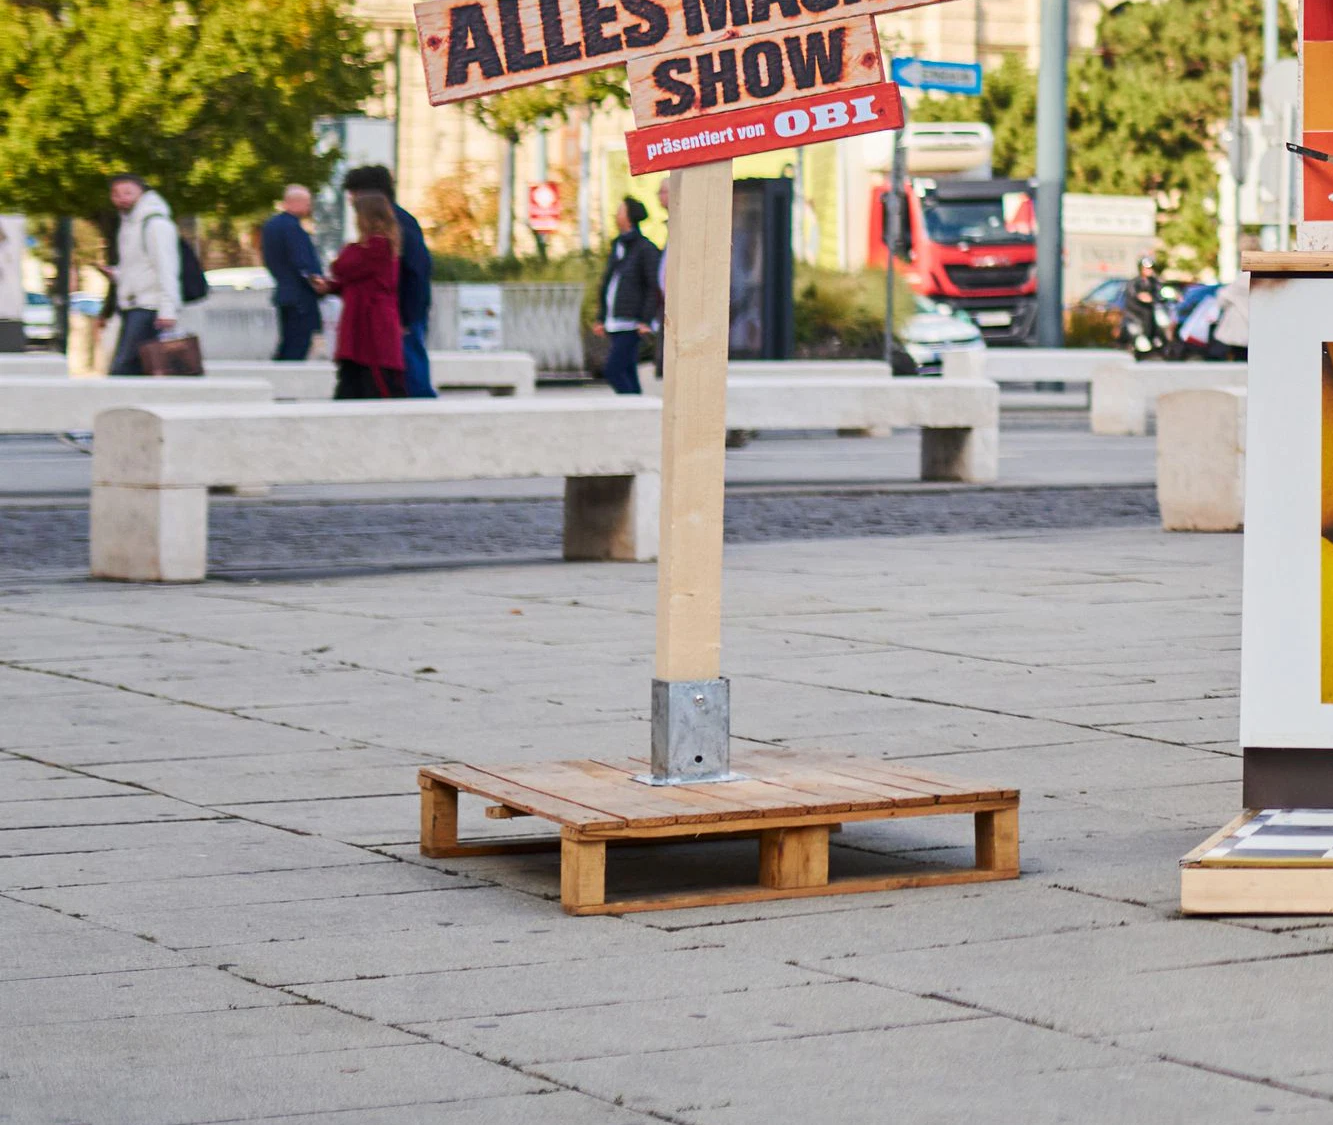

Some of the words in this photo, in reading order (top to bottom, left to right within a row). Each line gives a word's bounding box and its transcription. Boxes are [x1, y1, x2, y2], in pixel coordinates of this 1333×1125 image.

[654, 26, 848, 119] SHOW
[646, 129, 735, 161] präsentiert
[737, 122, 766, 141] von
[774, 95, 879, 139] OBI
